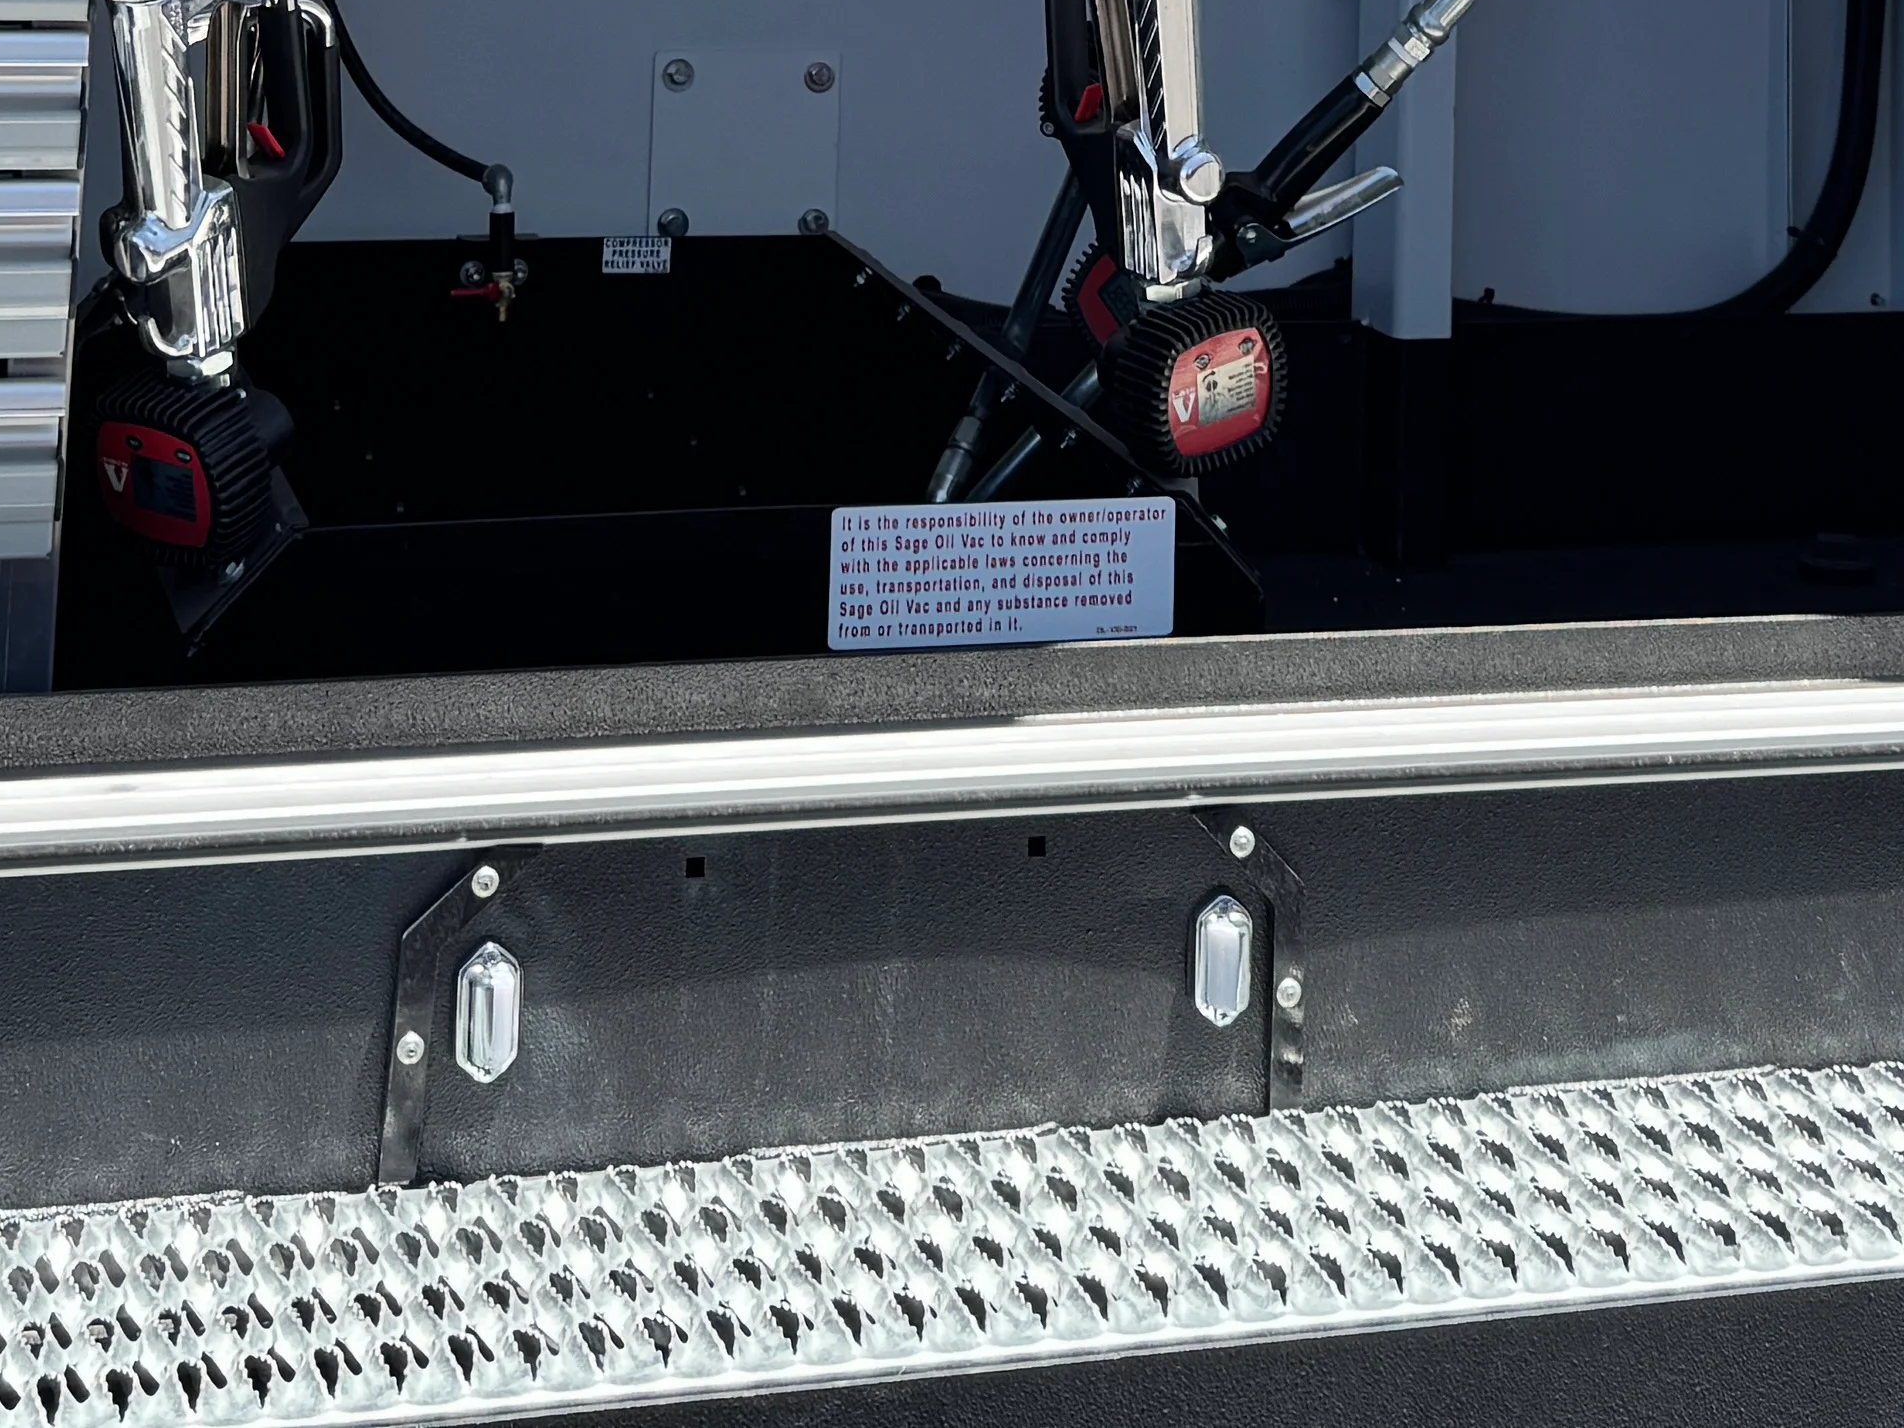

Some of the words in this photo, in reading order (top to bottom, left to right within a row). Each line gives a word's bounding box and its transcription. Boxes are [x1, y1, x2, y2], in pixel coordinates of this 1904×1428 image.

[605, 239, 669, 248] COMPRESSOR
[612, 249, 661, 258] PRESSURE
[604, 260, 636, 269] RELIEF
[640, 260, 667, 269] VALVE
[842, 515, 851, 531] It
[858, 514, 870, 530] is
[877, 514, 899, 530] the
[905, 511, 1006, 530] responsibility
[1012, 510, 1026, 526] of
[1032, 509, 1054, 525] the
[1059, 506, 1166, 525] owner/operator
[841, 537, 857, 553] of
[861, 535, 888, 552] this
[895, 535, 929, 554] Sage
[935, 533, 954, 549] Oil
[961, 533, 984, 549] Vac
[991, 532, 1004, 547] to
[1010, 531, 1046, 547] know
[1051, 529, 1076, 546] and
[1082, 528, 1131, 547] comply
[841, 558, 870, 574] with
[877, 557, 898, 573] the
[905, 555, 979, 575] applicable
[985, 553, 1016, 569] laws
[1022, 550, 1100, 569] concerning
[1106, 549, 1128, 565] the
[840, 582, 869, 598] use,
[876, 575, 986, 594] transportation,
[991, 574, 1016, 590] and
[1023, 572, 1083, 591] disposal
[1088, 570, 1102, 585] of
[1107, 569, 1134, 585] this
[839, 601, 873, 620] Sage
[879, 600, 900, 617] Oil
[906, 598, 930, 615] Vac
[936, 597, 961, 614] and
[967, 598, 991, 615] any
[997, 593, 1068, 611] substance
[1074, 590, 1132, 607] removed
[838, 622, 871, 639] from
[878, 624, 892, 638] or
[898, 618, 983, 638] transported
[988, 616, 1002, 632] in
[1007, 615, 1023, 632] it.
